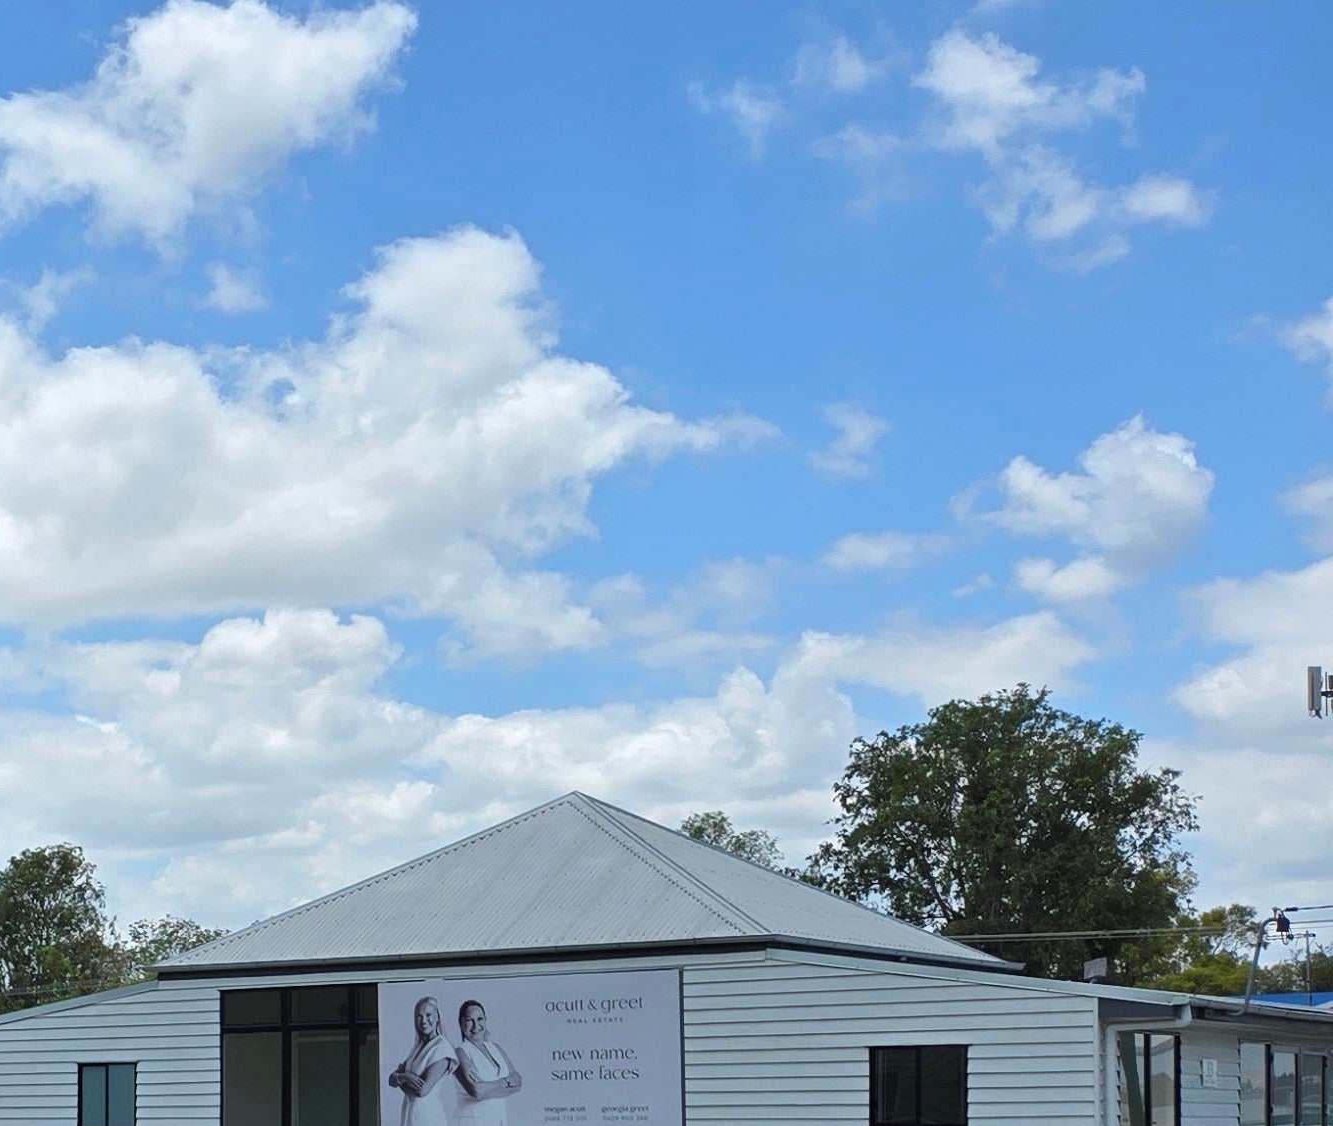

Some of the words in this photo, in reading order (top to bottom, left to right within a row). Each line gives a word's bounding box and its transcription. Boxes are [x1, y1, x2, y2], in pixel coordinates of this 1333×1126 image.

[544, 999, 584, 1013] acutt
[587, 998, 598, 1011] &
[600, 997, 643, 1014] greet
[552, 1049, 585, 1061] new
[551, 1068, 594, 1081] same
[599, 1064, 640, 1081] faces
